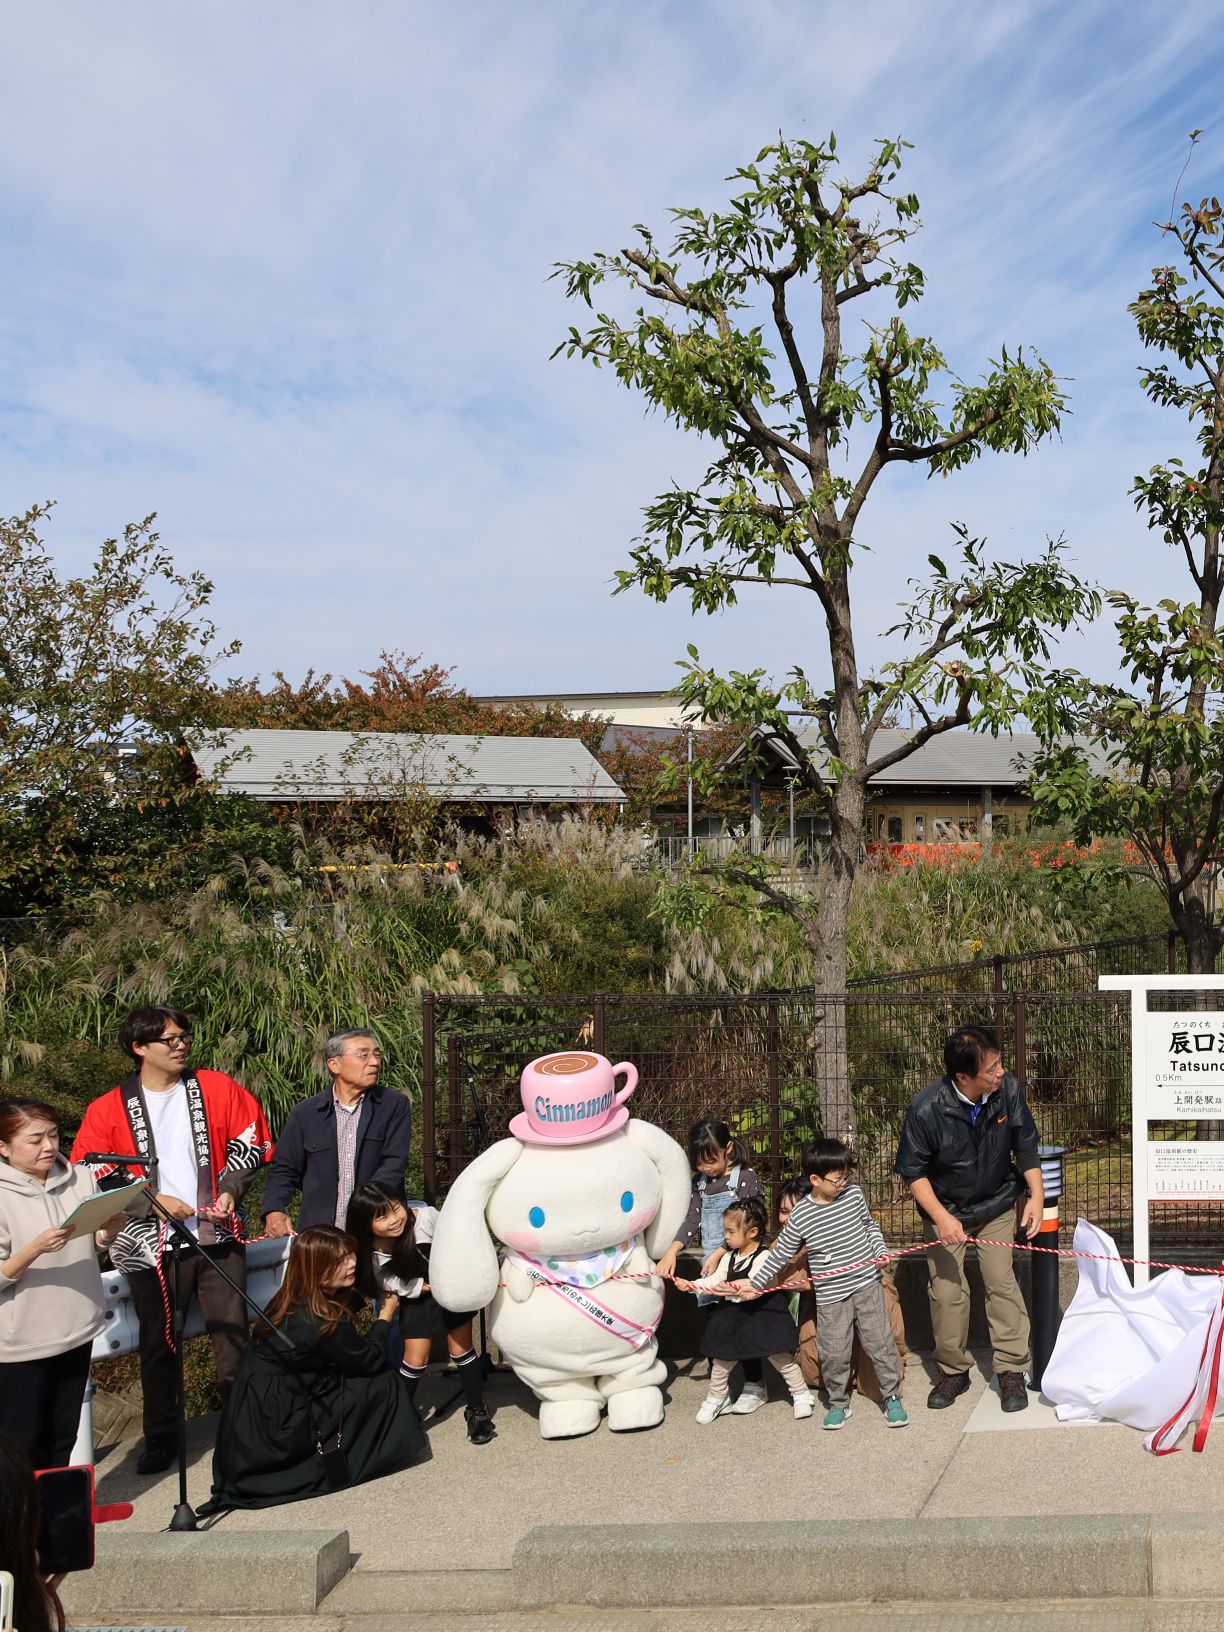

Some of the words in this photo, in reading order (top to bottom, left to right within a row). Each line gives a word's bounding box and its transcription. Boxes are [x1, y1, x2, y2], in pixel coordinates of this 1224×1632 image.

[1155, 1074, 1182, 1082] 0.5Km
[535, 1090, 613, 1122] Cinnamon
[186, 1078, 210, 1167] 辰口温泉観光協会
